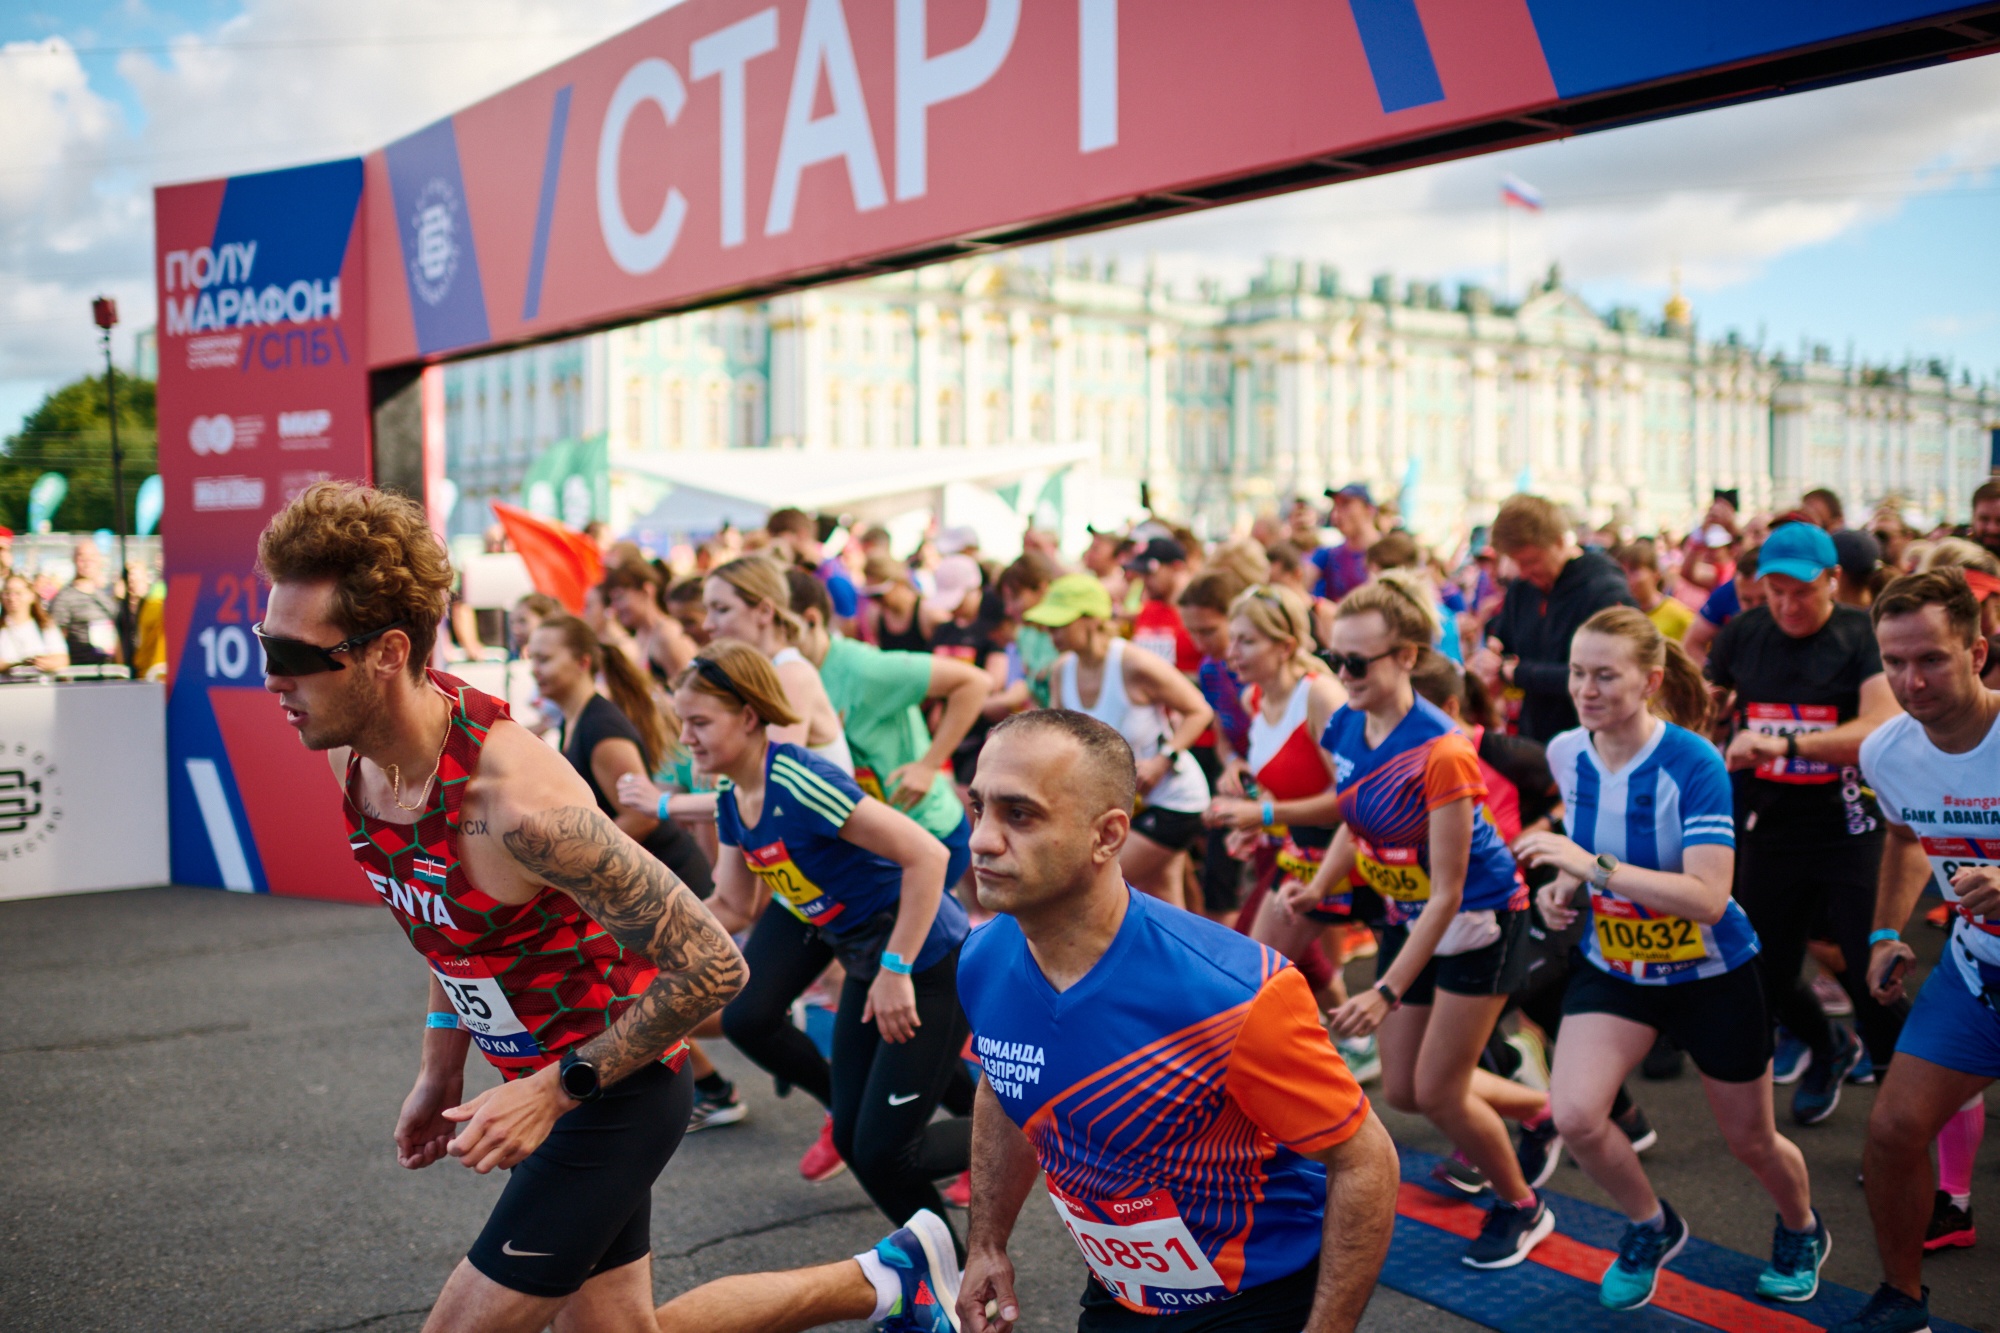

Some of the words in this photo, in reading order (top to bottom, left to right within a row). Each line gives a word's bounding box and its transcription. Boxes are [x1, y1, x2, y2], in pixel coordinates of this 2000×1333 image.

[166, 240, 257, 292] ПОЛУ
[167, 276, 341, 337] МАРАФОН
[198, 626, 249, 679] 10
[1902, 808, 1936, 824] БАНК
[361, 865, 458, 930] ENYA
[1600, 918, 1696, 950] 10632
[444, 980, 492, 1020] 35
[977, 1035, 1045, 1066] КОМАНДА
[980, 1055, 1041, 1085] ГАЗПРОМ
[1113, 1198, 1153, 1214] 07.08
[1156, 1291, 1178, 1305] 10
